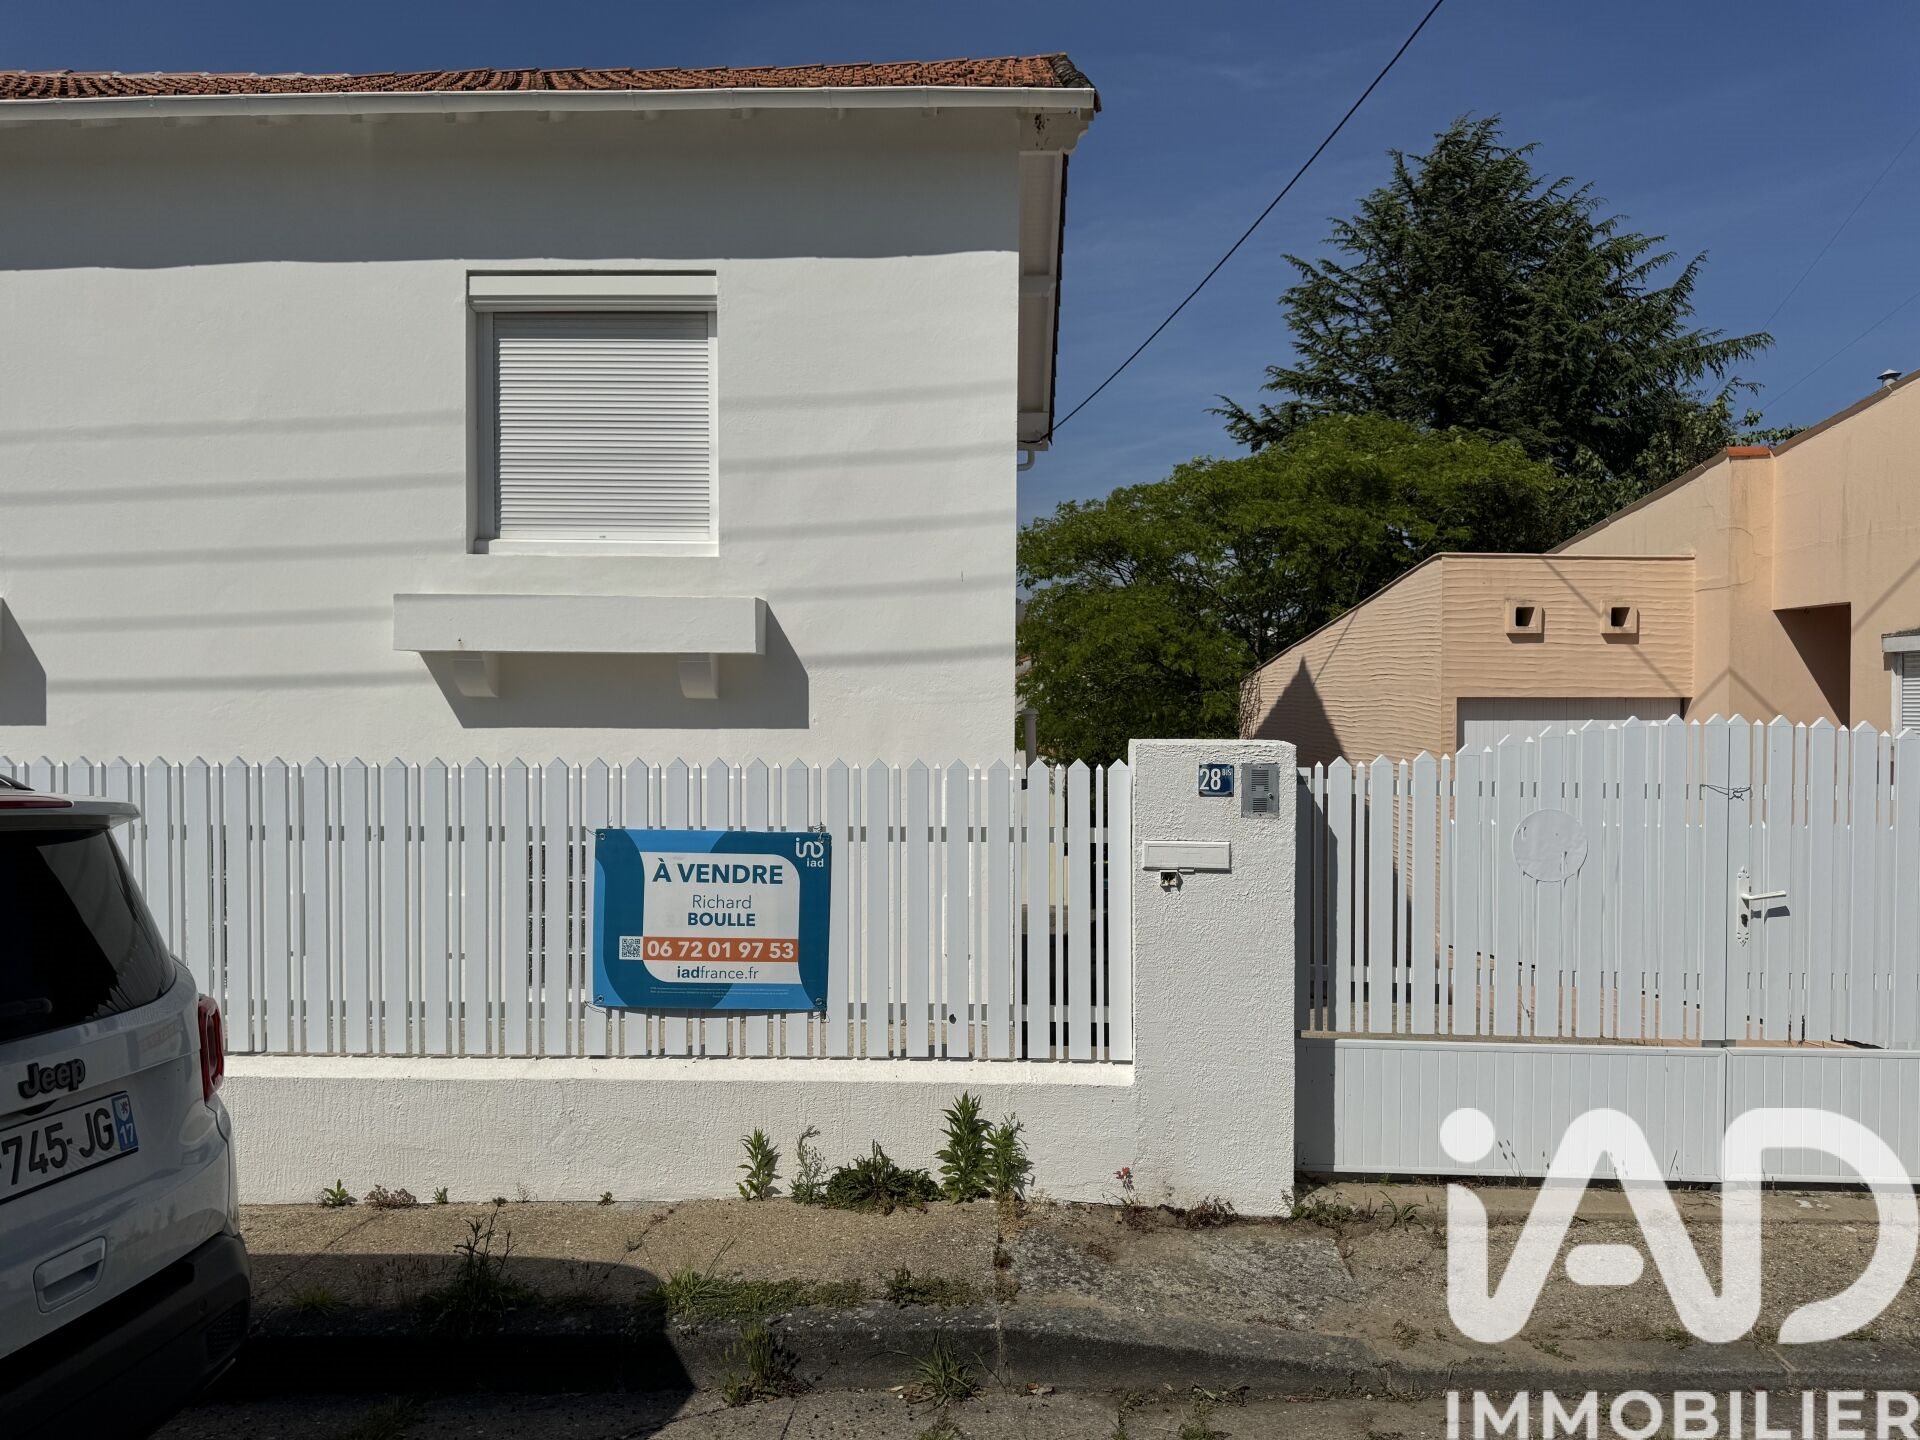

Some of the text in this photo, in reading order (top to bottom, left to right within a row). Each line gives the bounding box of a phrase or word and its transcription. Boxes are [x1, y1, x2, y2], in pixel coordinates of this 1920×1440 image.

[1200, 768, 1221, 790] 28
[652, 857, 783, 885] À VENDRE
[806, 857, 824, 868] iad
[692, 894, 752, 909] Richard
[687, 912, 756, 927] BOULLE
[647, 940, 794, 959] 06 72 01 97 53
[677, 966, 759, 980] iadfrance.fr
[17, 1058, 86, 1098] Jeep
[119, 1123, 134, 1145] 17
